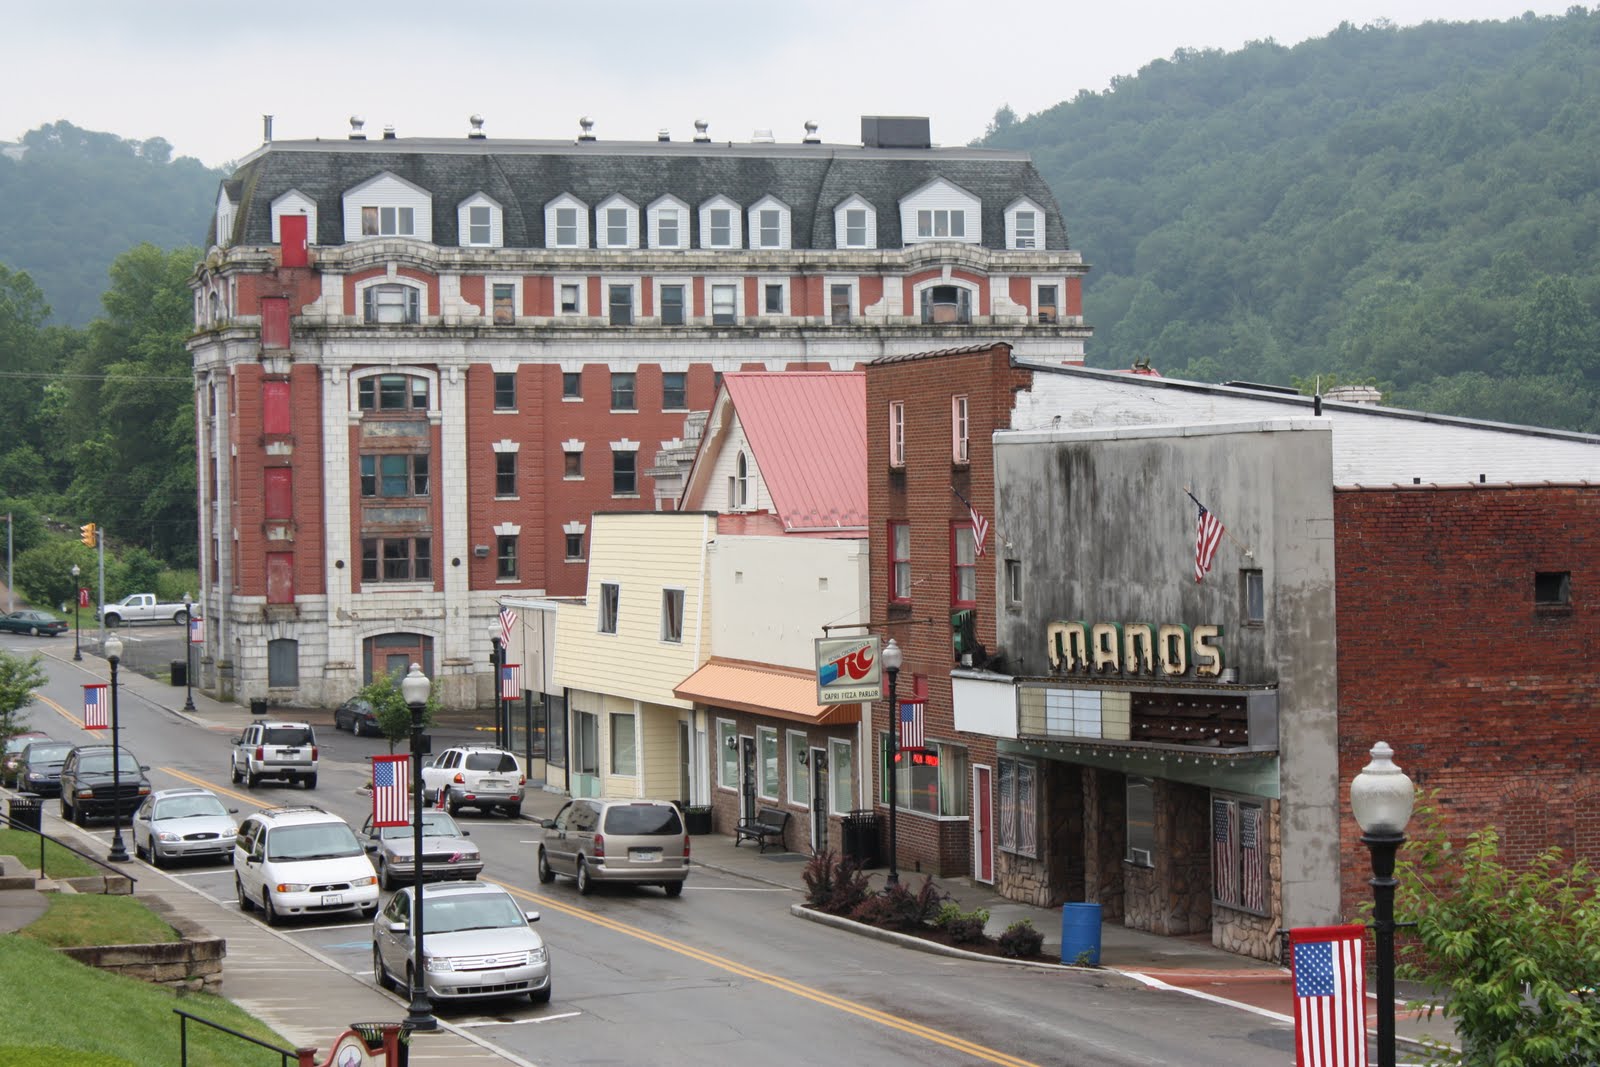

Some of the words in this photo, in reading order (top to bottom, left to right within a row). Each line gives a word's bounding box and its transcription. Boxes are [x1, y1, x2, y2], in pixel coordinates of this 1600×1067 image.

[829, 645, 874, 680] RC
[1047, 620, 1225, 678] MANOS
[858, 690, 878, 698] PARLOR
